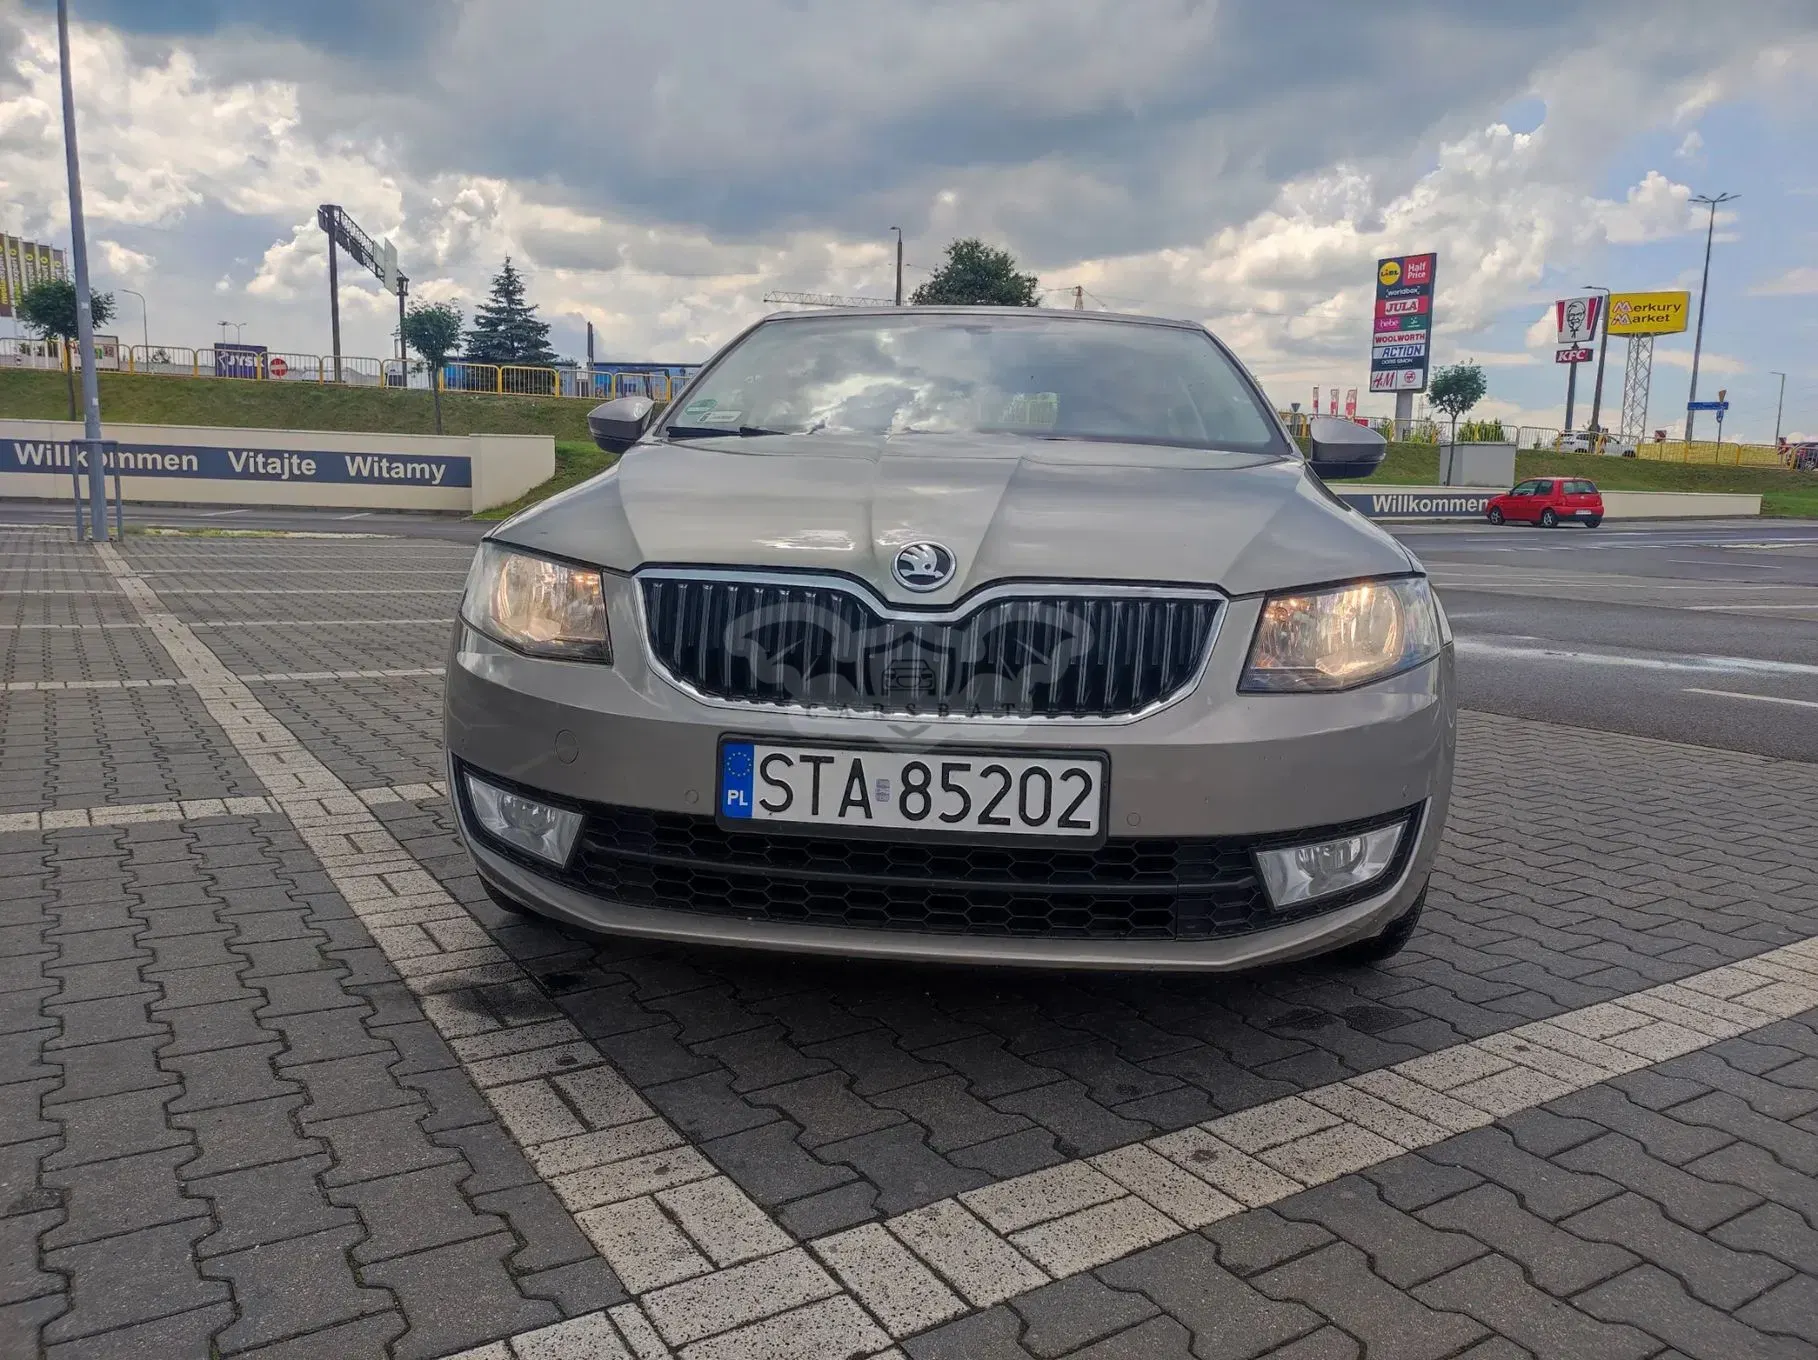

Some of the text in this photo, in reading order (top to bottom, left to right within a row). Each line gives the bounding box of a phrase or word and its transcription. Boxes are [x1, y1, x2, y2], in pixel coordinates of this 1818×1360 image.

[1408, 262, 1426, 272] Half
[1407, 271, 1426, 279] Price
[1612, 300, 1682, 313] Merkury
[1611, 313, 1670, 325] Market
[1375, 333, 1425, 343] WOOLWORTH
[1382, 345, 1422, 357] ACTION
[1558, 350, 1585, 361] KFC
[228, 451, 317, 479] Vitajte
[345, 455, 446, 485] Witamy
[759, 752, 1092, 829] STA 85202
[727, 789, 748, 806] PL
